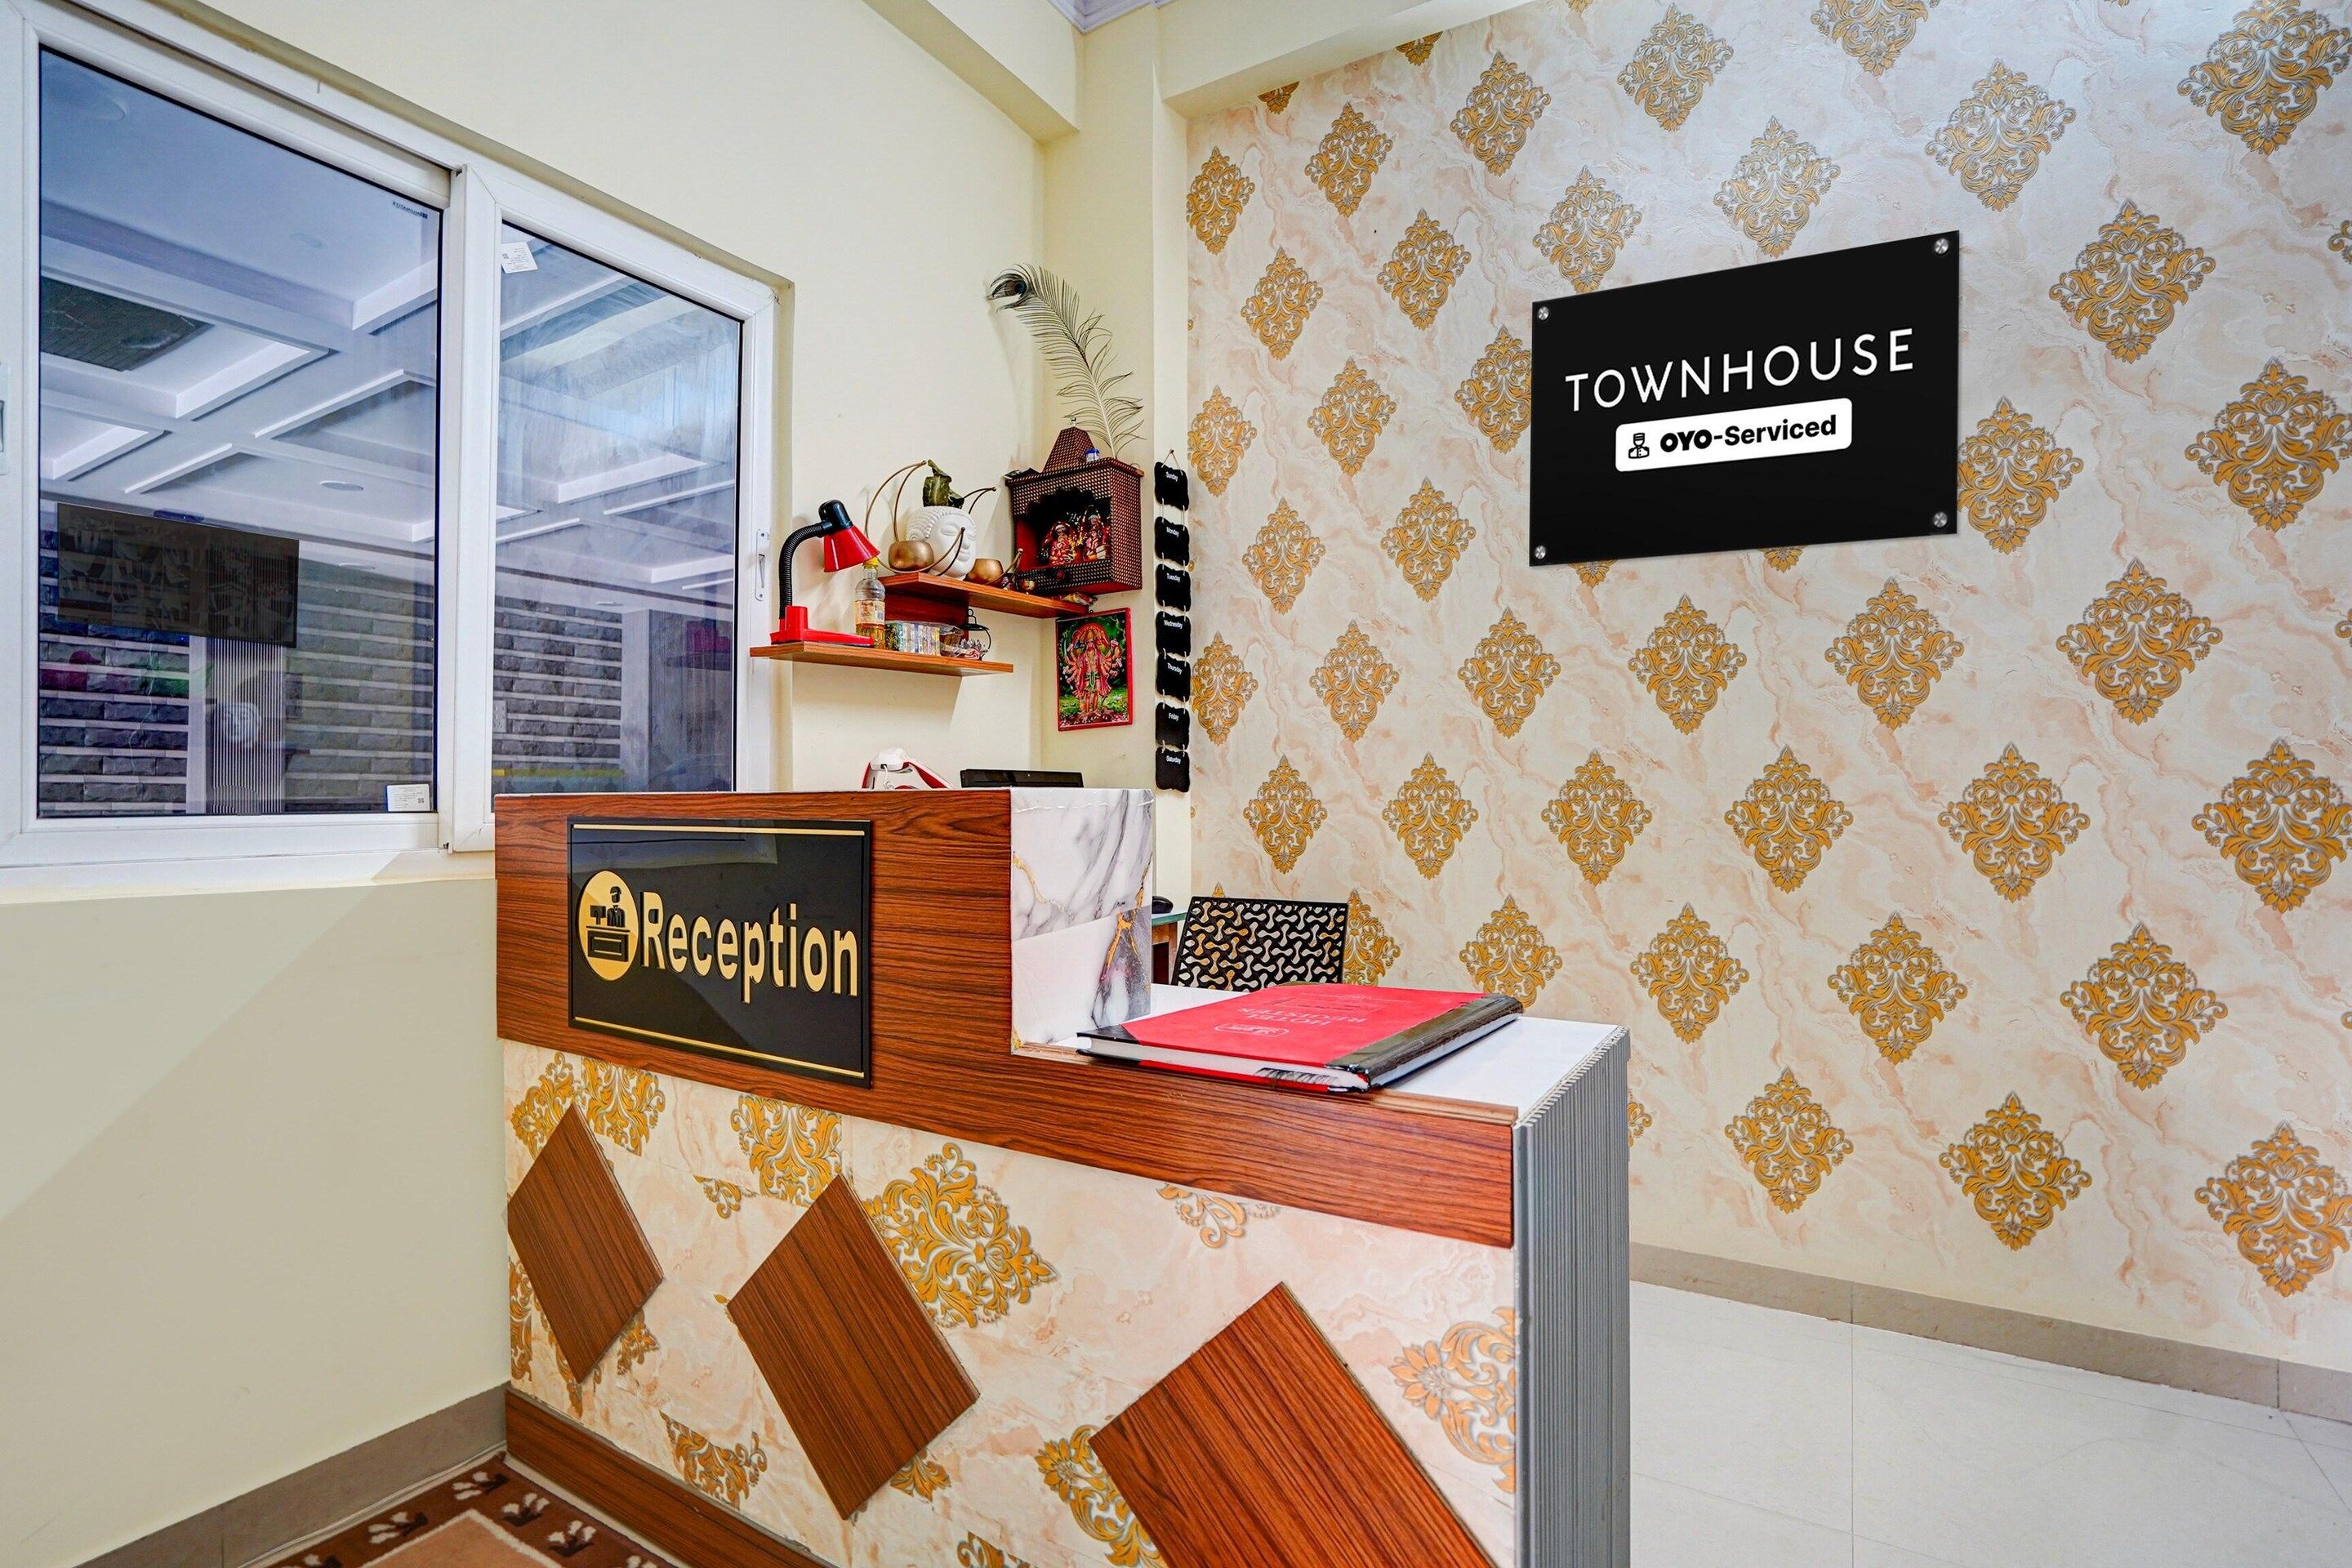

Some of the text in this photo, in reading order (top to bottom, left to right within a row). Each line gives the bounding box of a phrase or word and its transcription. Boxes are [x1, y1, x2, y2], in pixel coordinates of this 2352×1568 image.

[1565, 328, 1913, 412] TOWNHOUSE
[1660, 414, 1836, 453] OYO-Serviced
[1165, 471, 1178, 482] Sunday
[1166, 526, 1179, 537] Monday
[1166, 572, 1181, 583] Tuesday
[1164, 620, 1183, 630] Wednesday
[1167, 662, 1183, 675] Thursday
[1168, 712, 1179, 722] Friday
[1165, 755, 1181, 765] Saturday
[641, 891, 858, 1004] Reception
